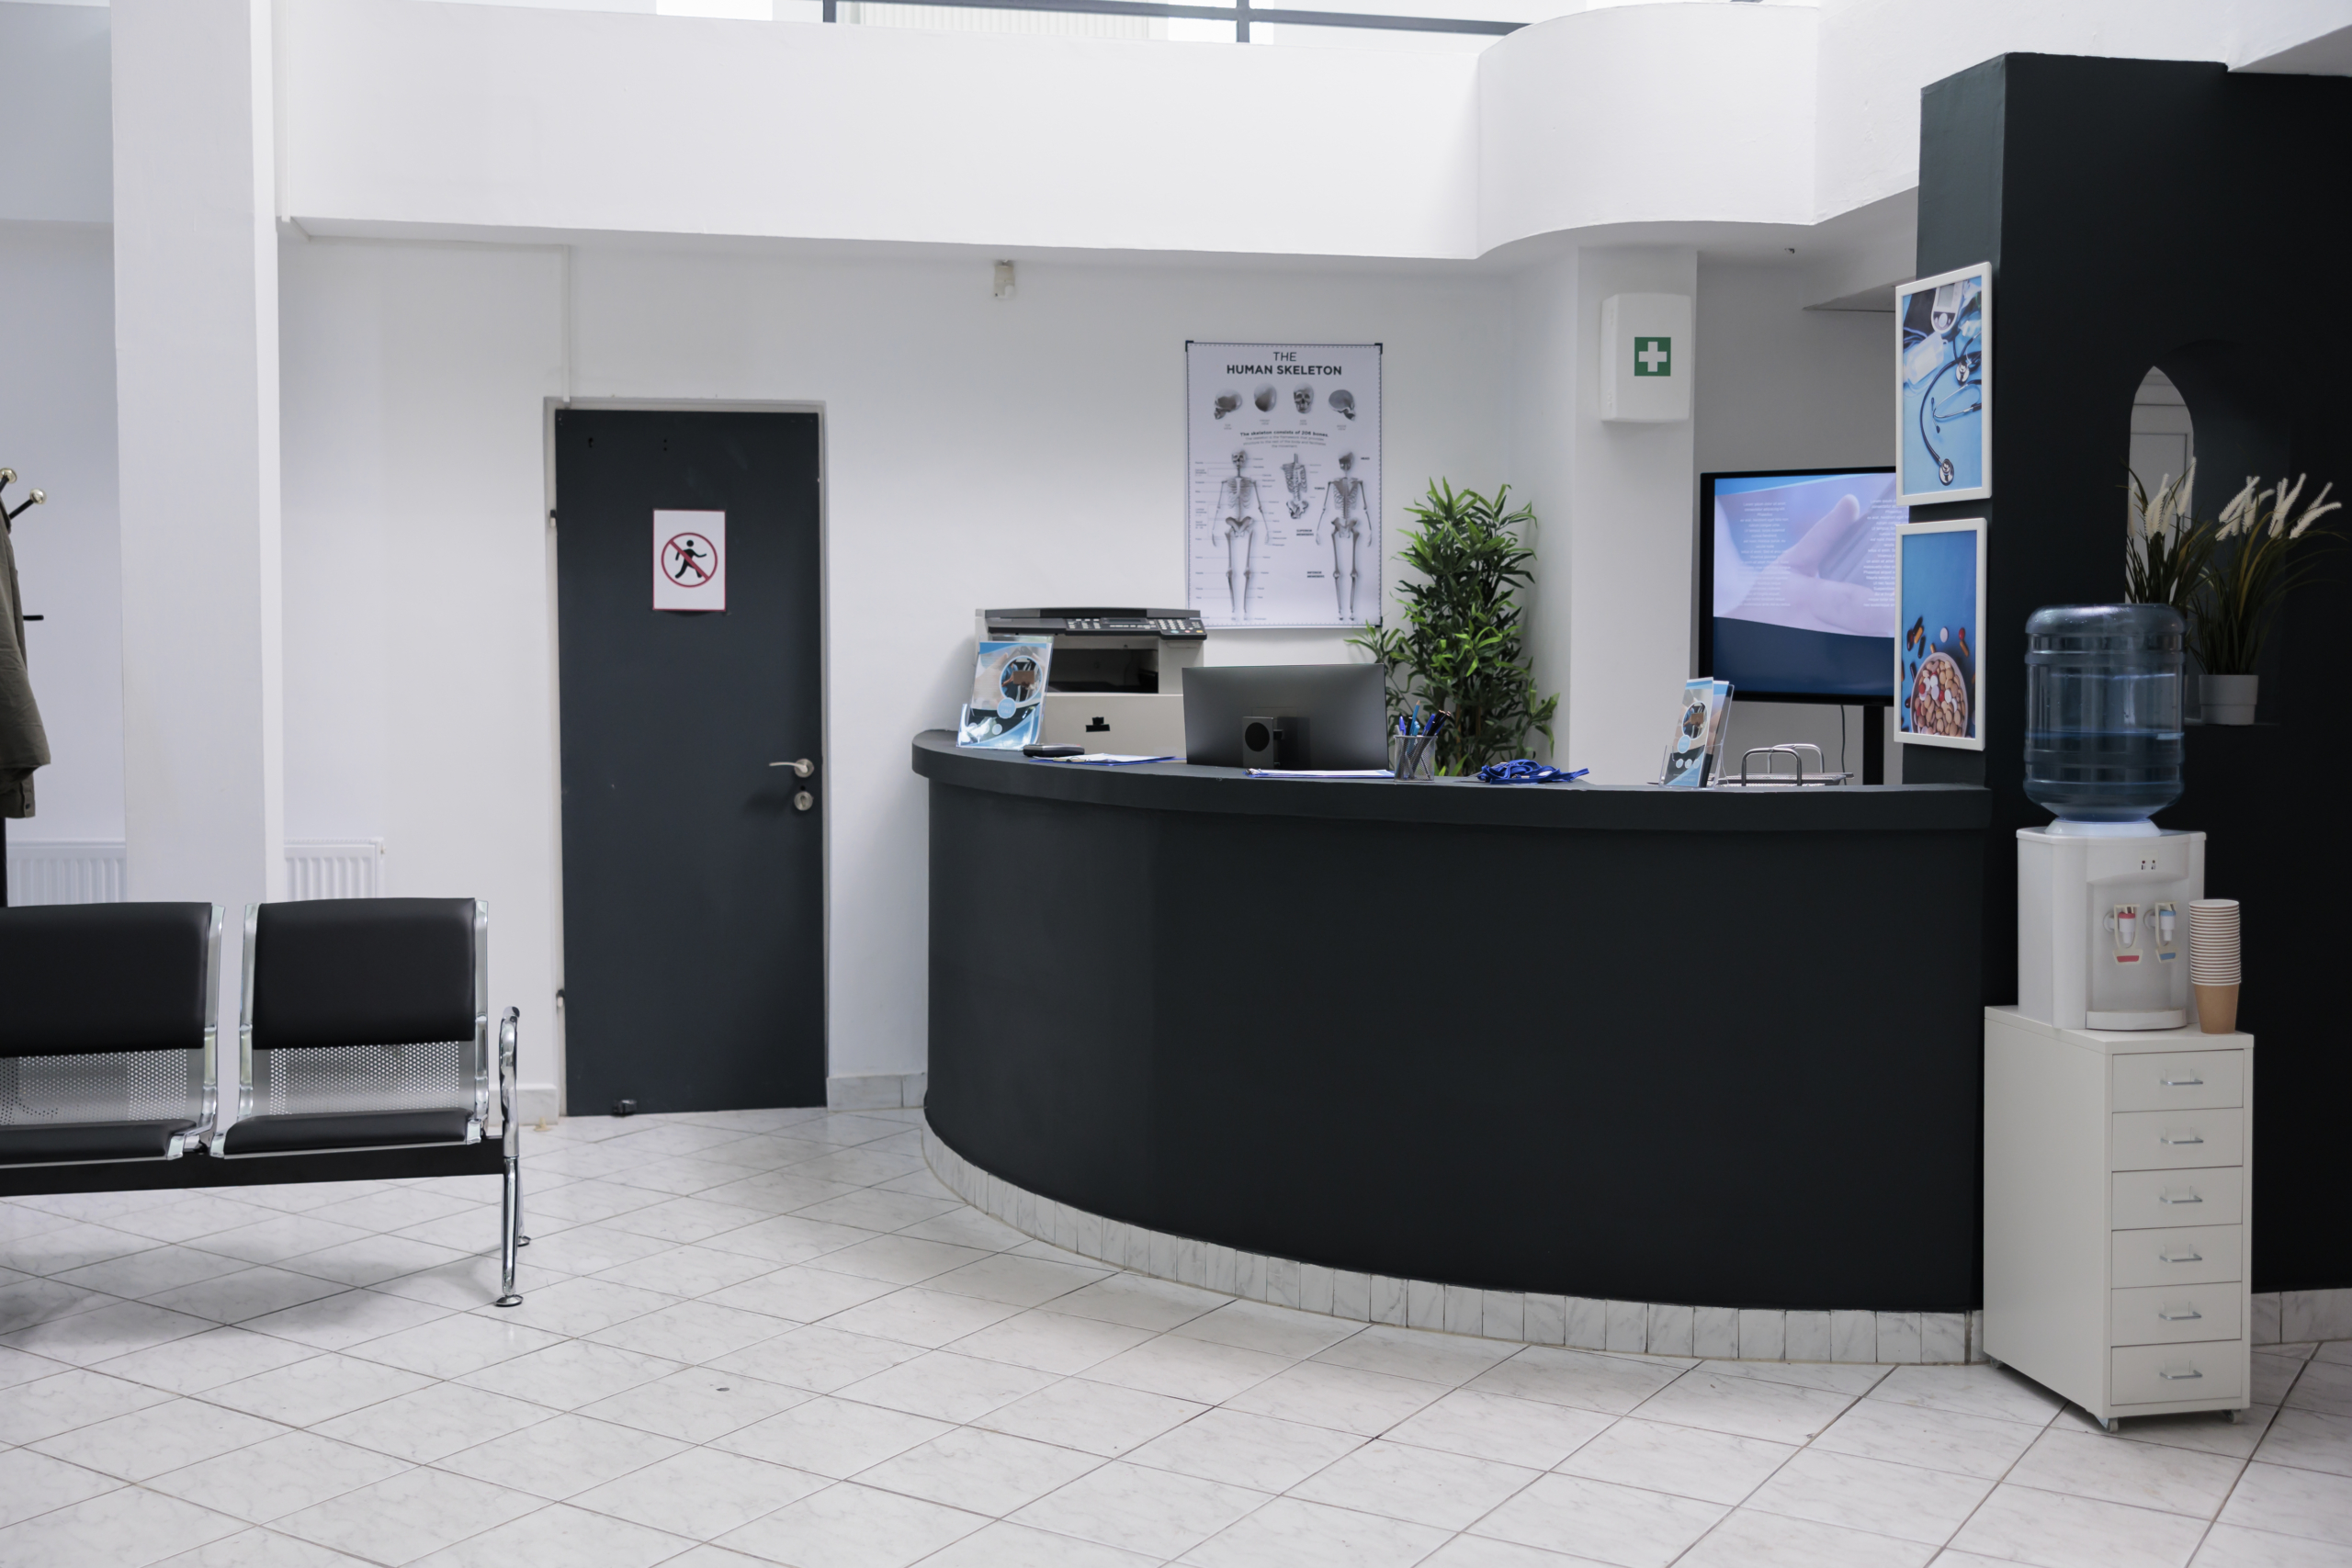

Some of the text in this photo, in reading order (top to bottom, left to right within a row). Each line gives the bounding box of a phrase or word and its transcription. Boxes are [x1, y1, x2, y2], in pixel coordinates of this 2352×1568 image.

[1272, 351, 1297, 361] THE
[1227, 365, 1342, 375] HUMAN SKELETON
